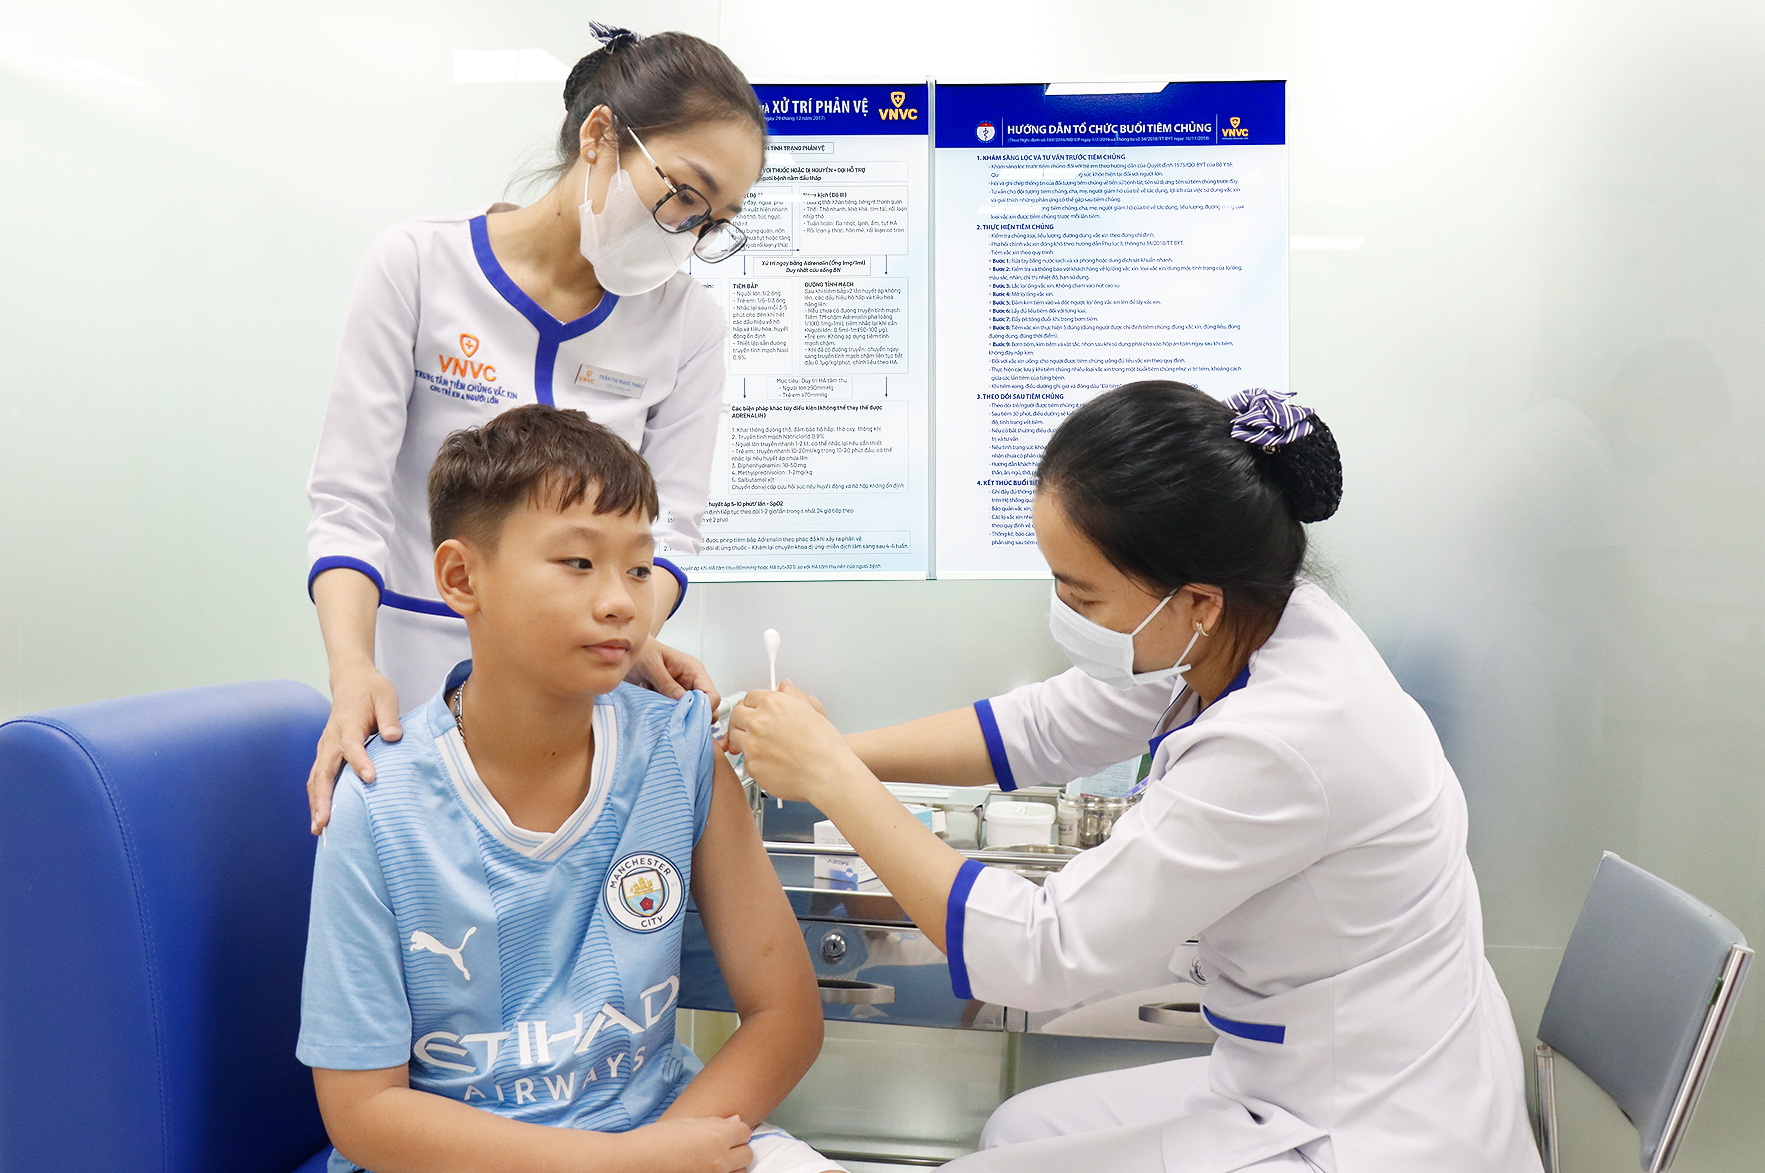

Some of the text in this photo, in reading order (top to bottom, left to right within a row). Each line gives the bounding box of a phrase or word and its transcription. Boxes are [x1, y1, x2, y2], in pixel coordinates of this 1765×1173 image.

[773, 96, 790, 114] XỬ
[792, 98, 812, 114] TRÍ
[816, 96, 850, 114] PHẢN
[852, 97, 869, 117] VỆ
[878, 108, 918, 121] VNVC
[1007, 121, 1212, 134] HƯỚNG DẪN TỔ CHỨC BUỔI TIÊM CHỦNG
[1222, 128, 1249, 137] VNVC
[438, 354, 497, 382] VNVC
[415, 369, 518, 400] TRUNG TÂM TIÊM CHỦNG VẮC XIN
[579, 375, 596, 384] VNVC
[610, 857, 672, 889] MANCHESTER
[640, 915, 664, 928] CITY
[413, 975, 680, 1073] ETIHAD
[464, 1046, 646, 1105] AIRWAYS
